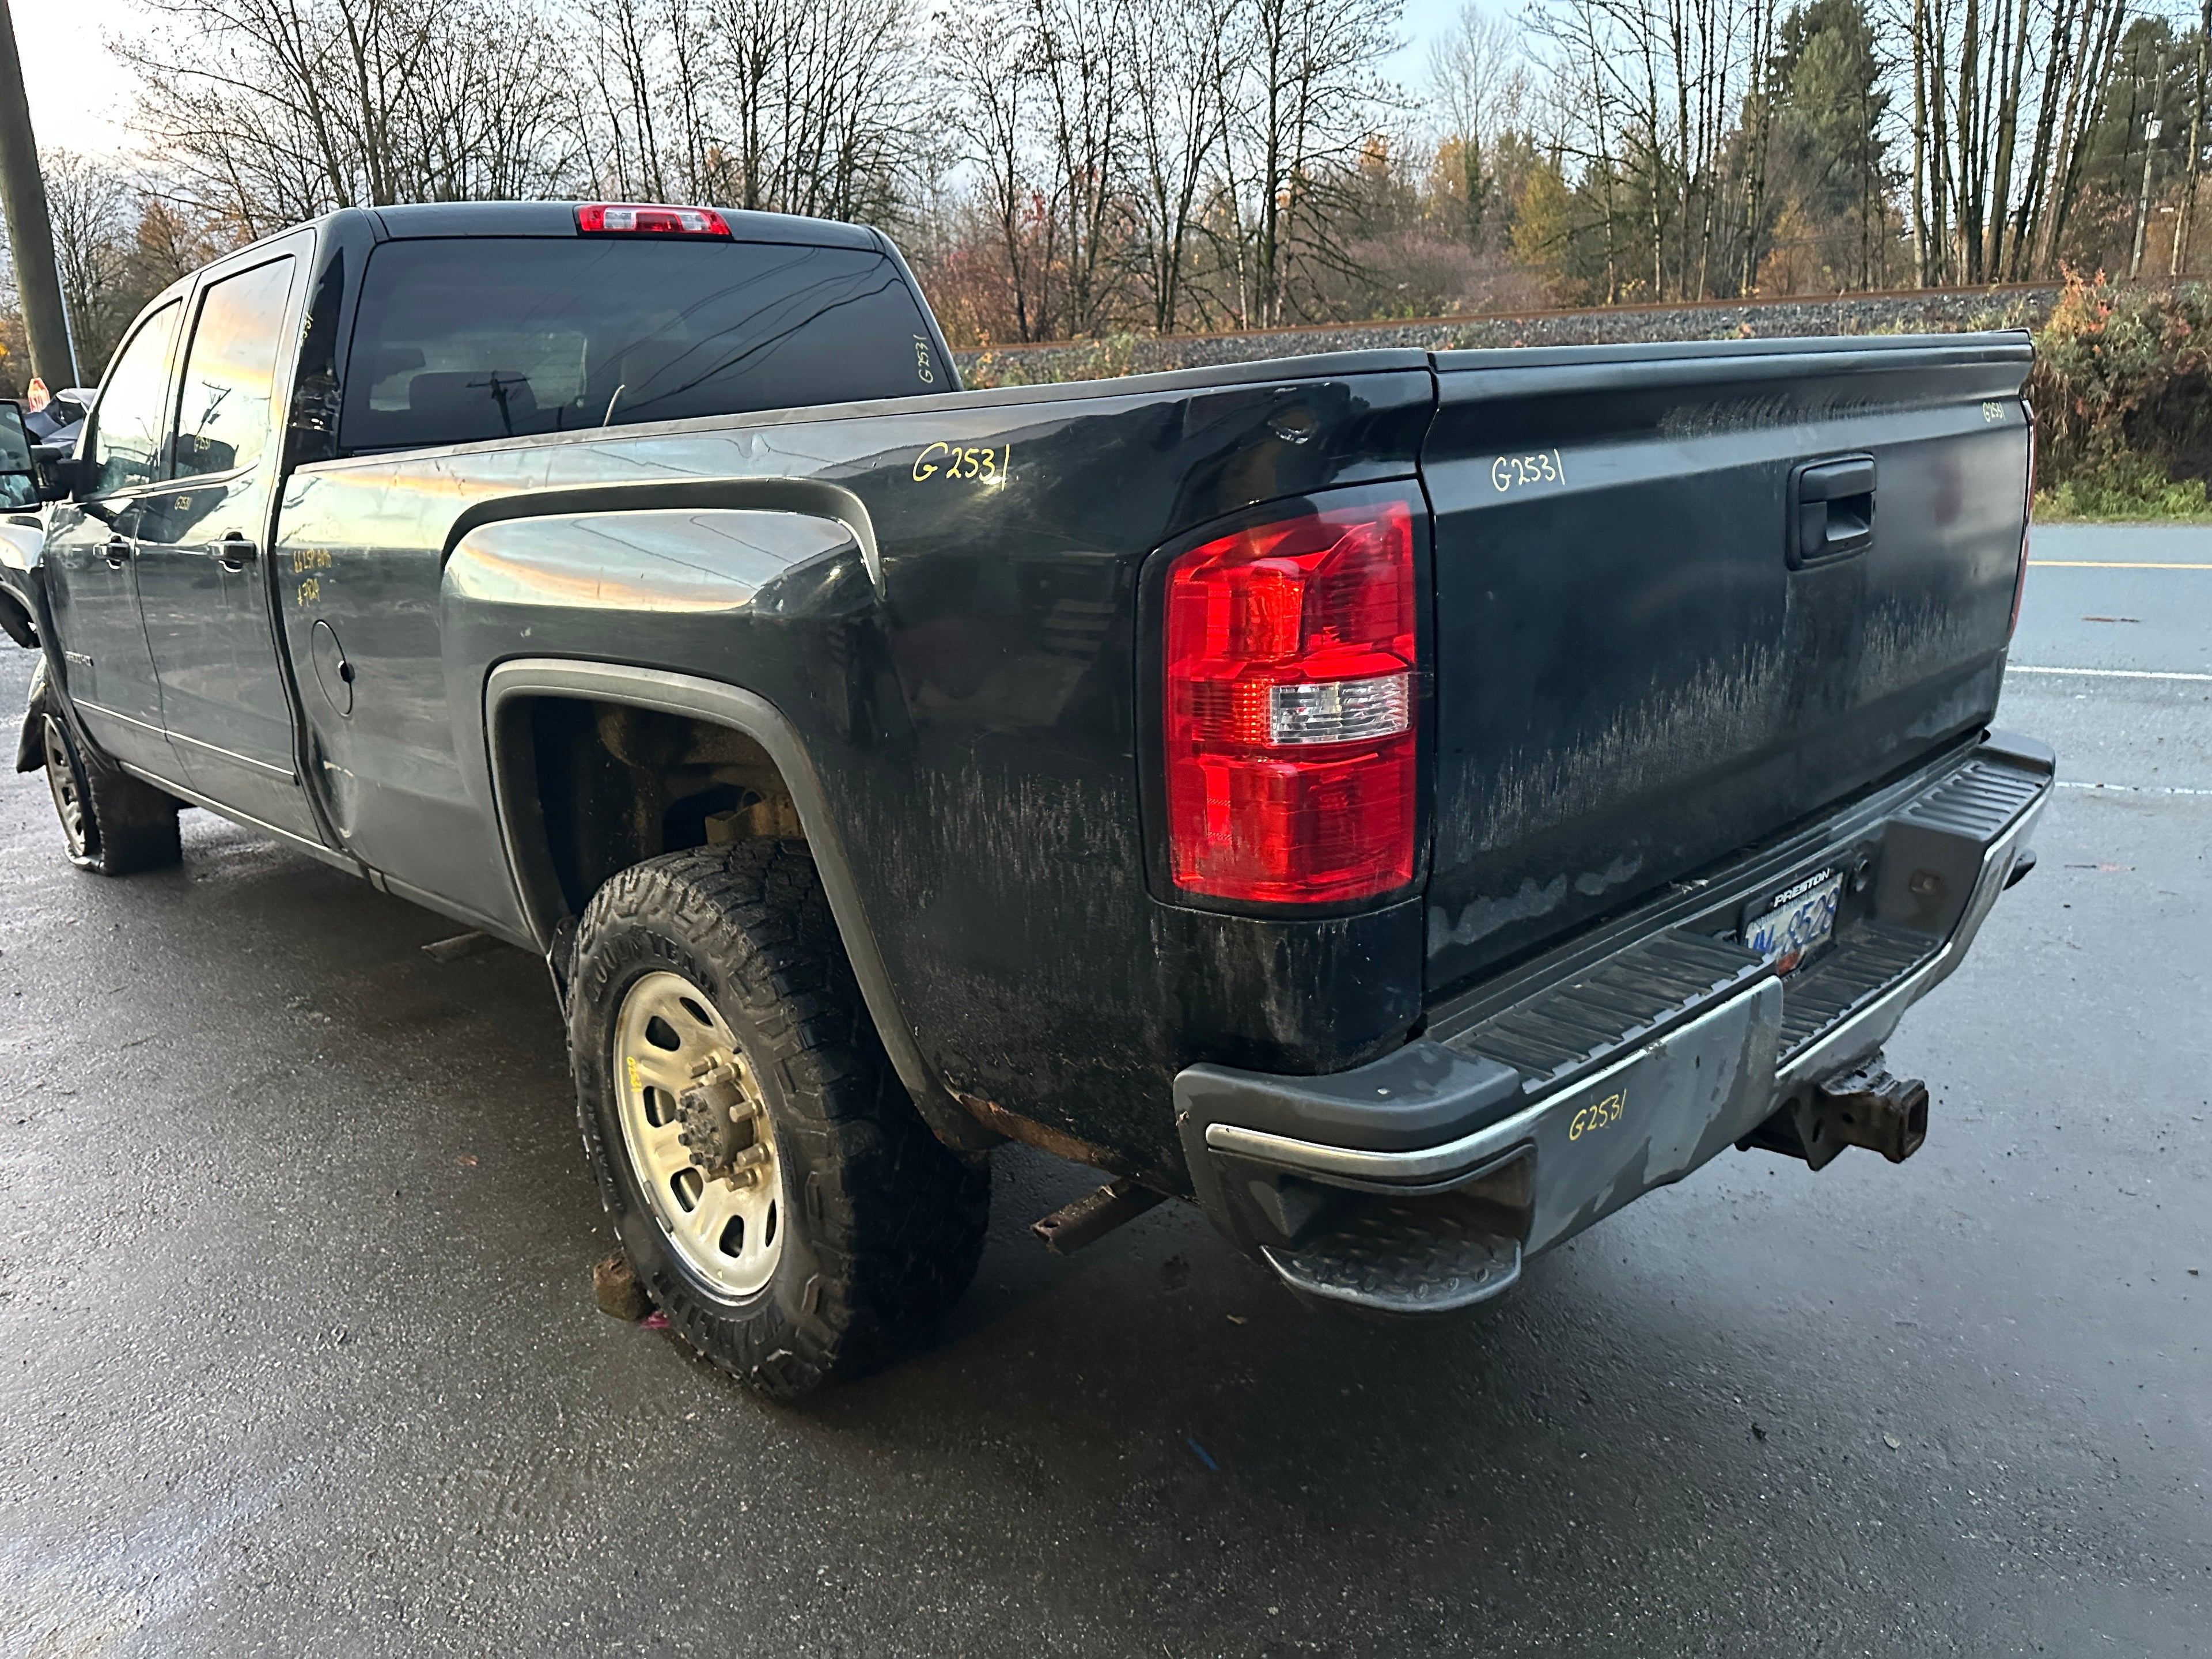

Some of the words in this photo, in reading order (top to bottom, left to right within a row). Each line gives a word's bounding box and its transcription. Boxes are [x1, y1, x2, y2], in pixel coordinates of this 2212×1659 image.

[912, 334, 933, 384] G2531
[912, 442, 1010, 491] G2531
[1492, 448, 1565, 491] G2531
[1774, 868, 1830, 908] PRESTON
[1569, 1088, 1627, 1141] G2531
